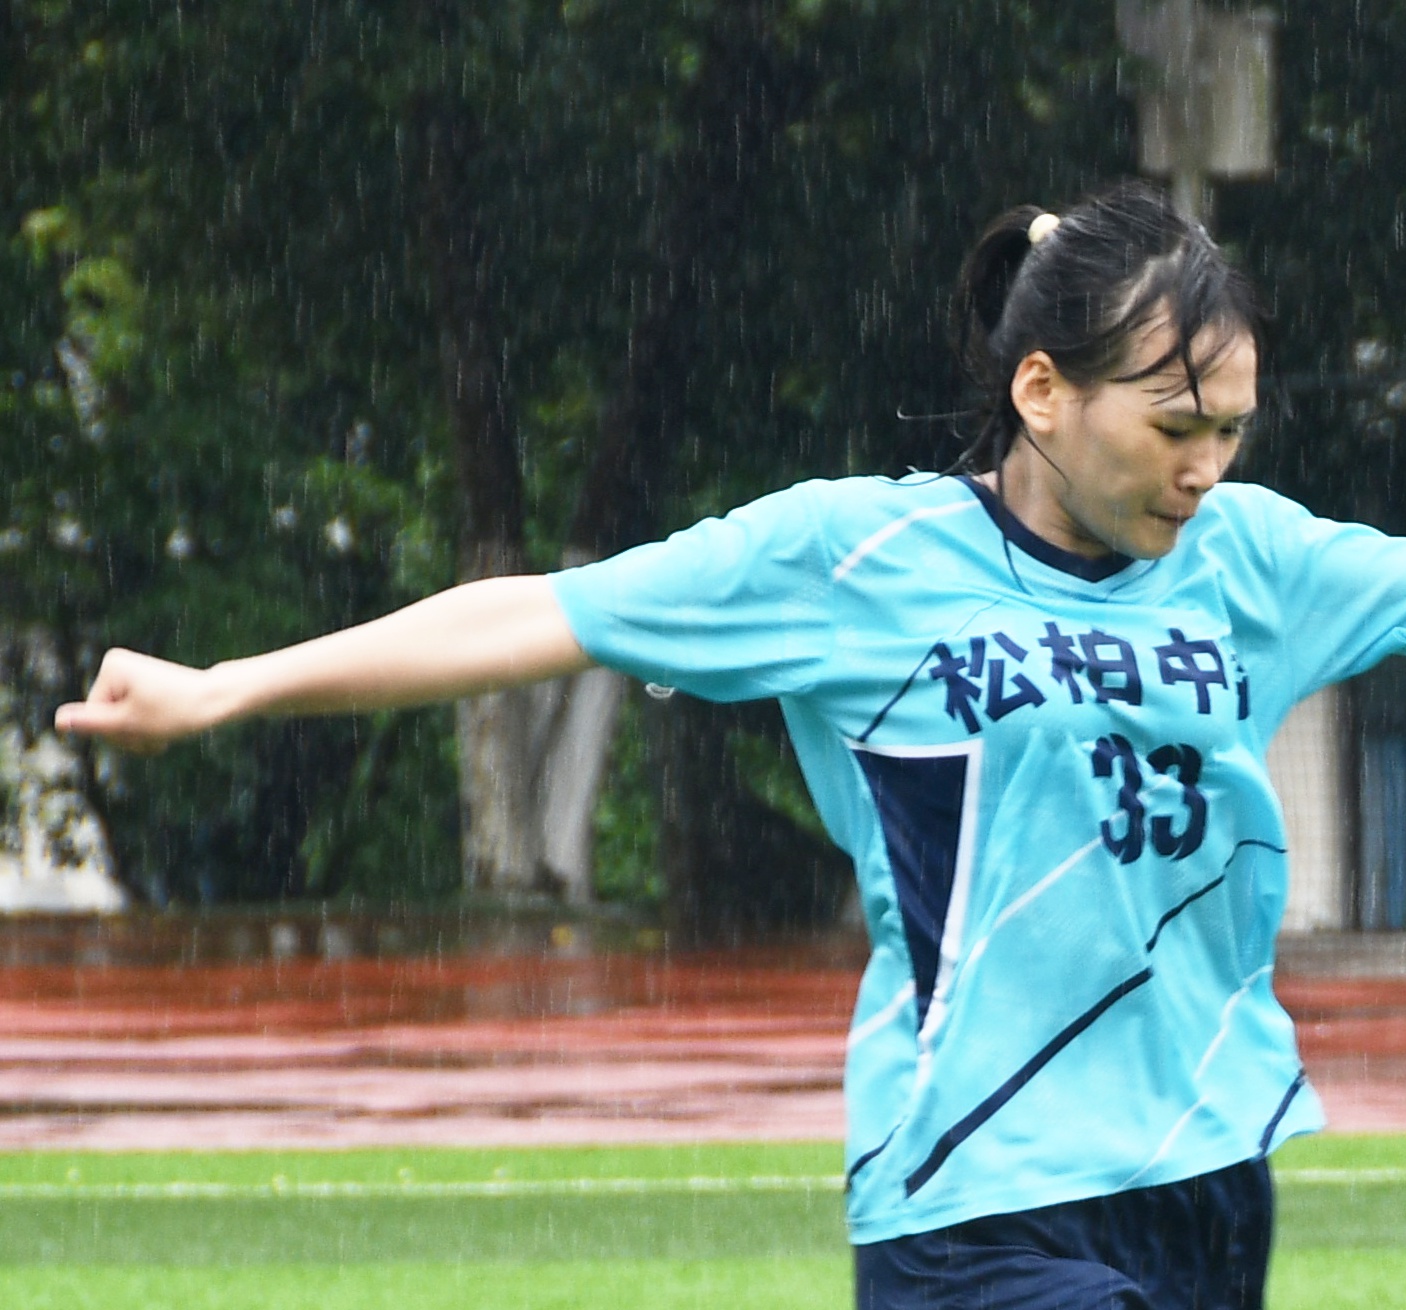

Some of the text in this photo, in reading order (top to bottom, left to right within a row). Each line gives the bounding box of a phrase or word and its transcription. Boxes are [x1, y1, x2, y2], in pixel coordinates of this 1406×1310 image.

[929, 621, 1250, 735] 松柏中
[1091, 732, 1208, 866] 33
